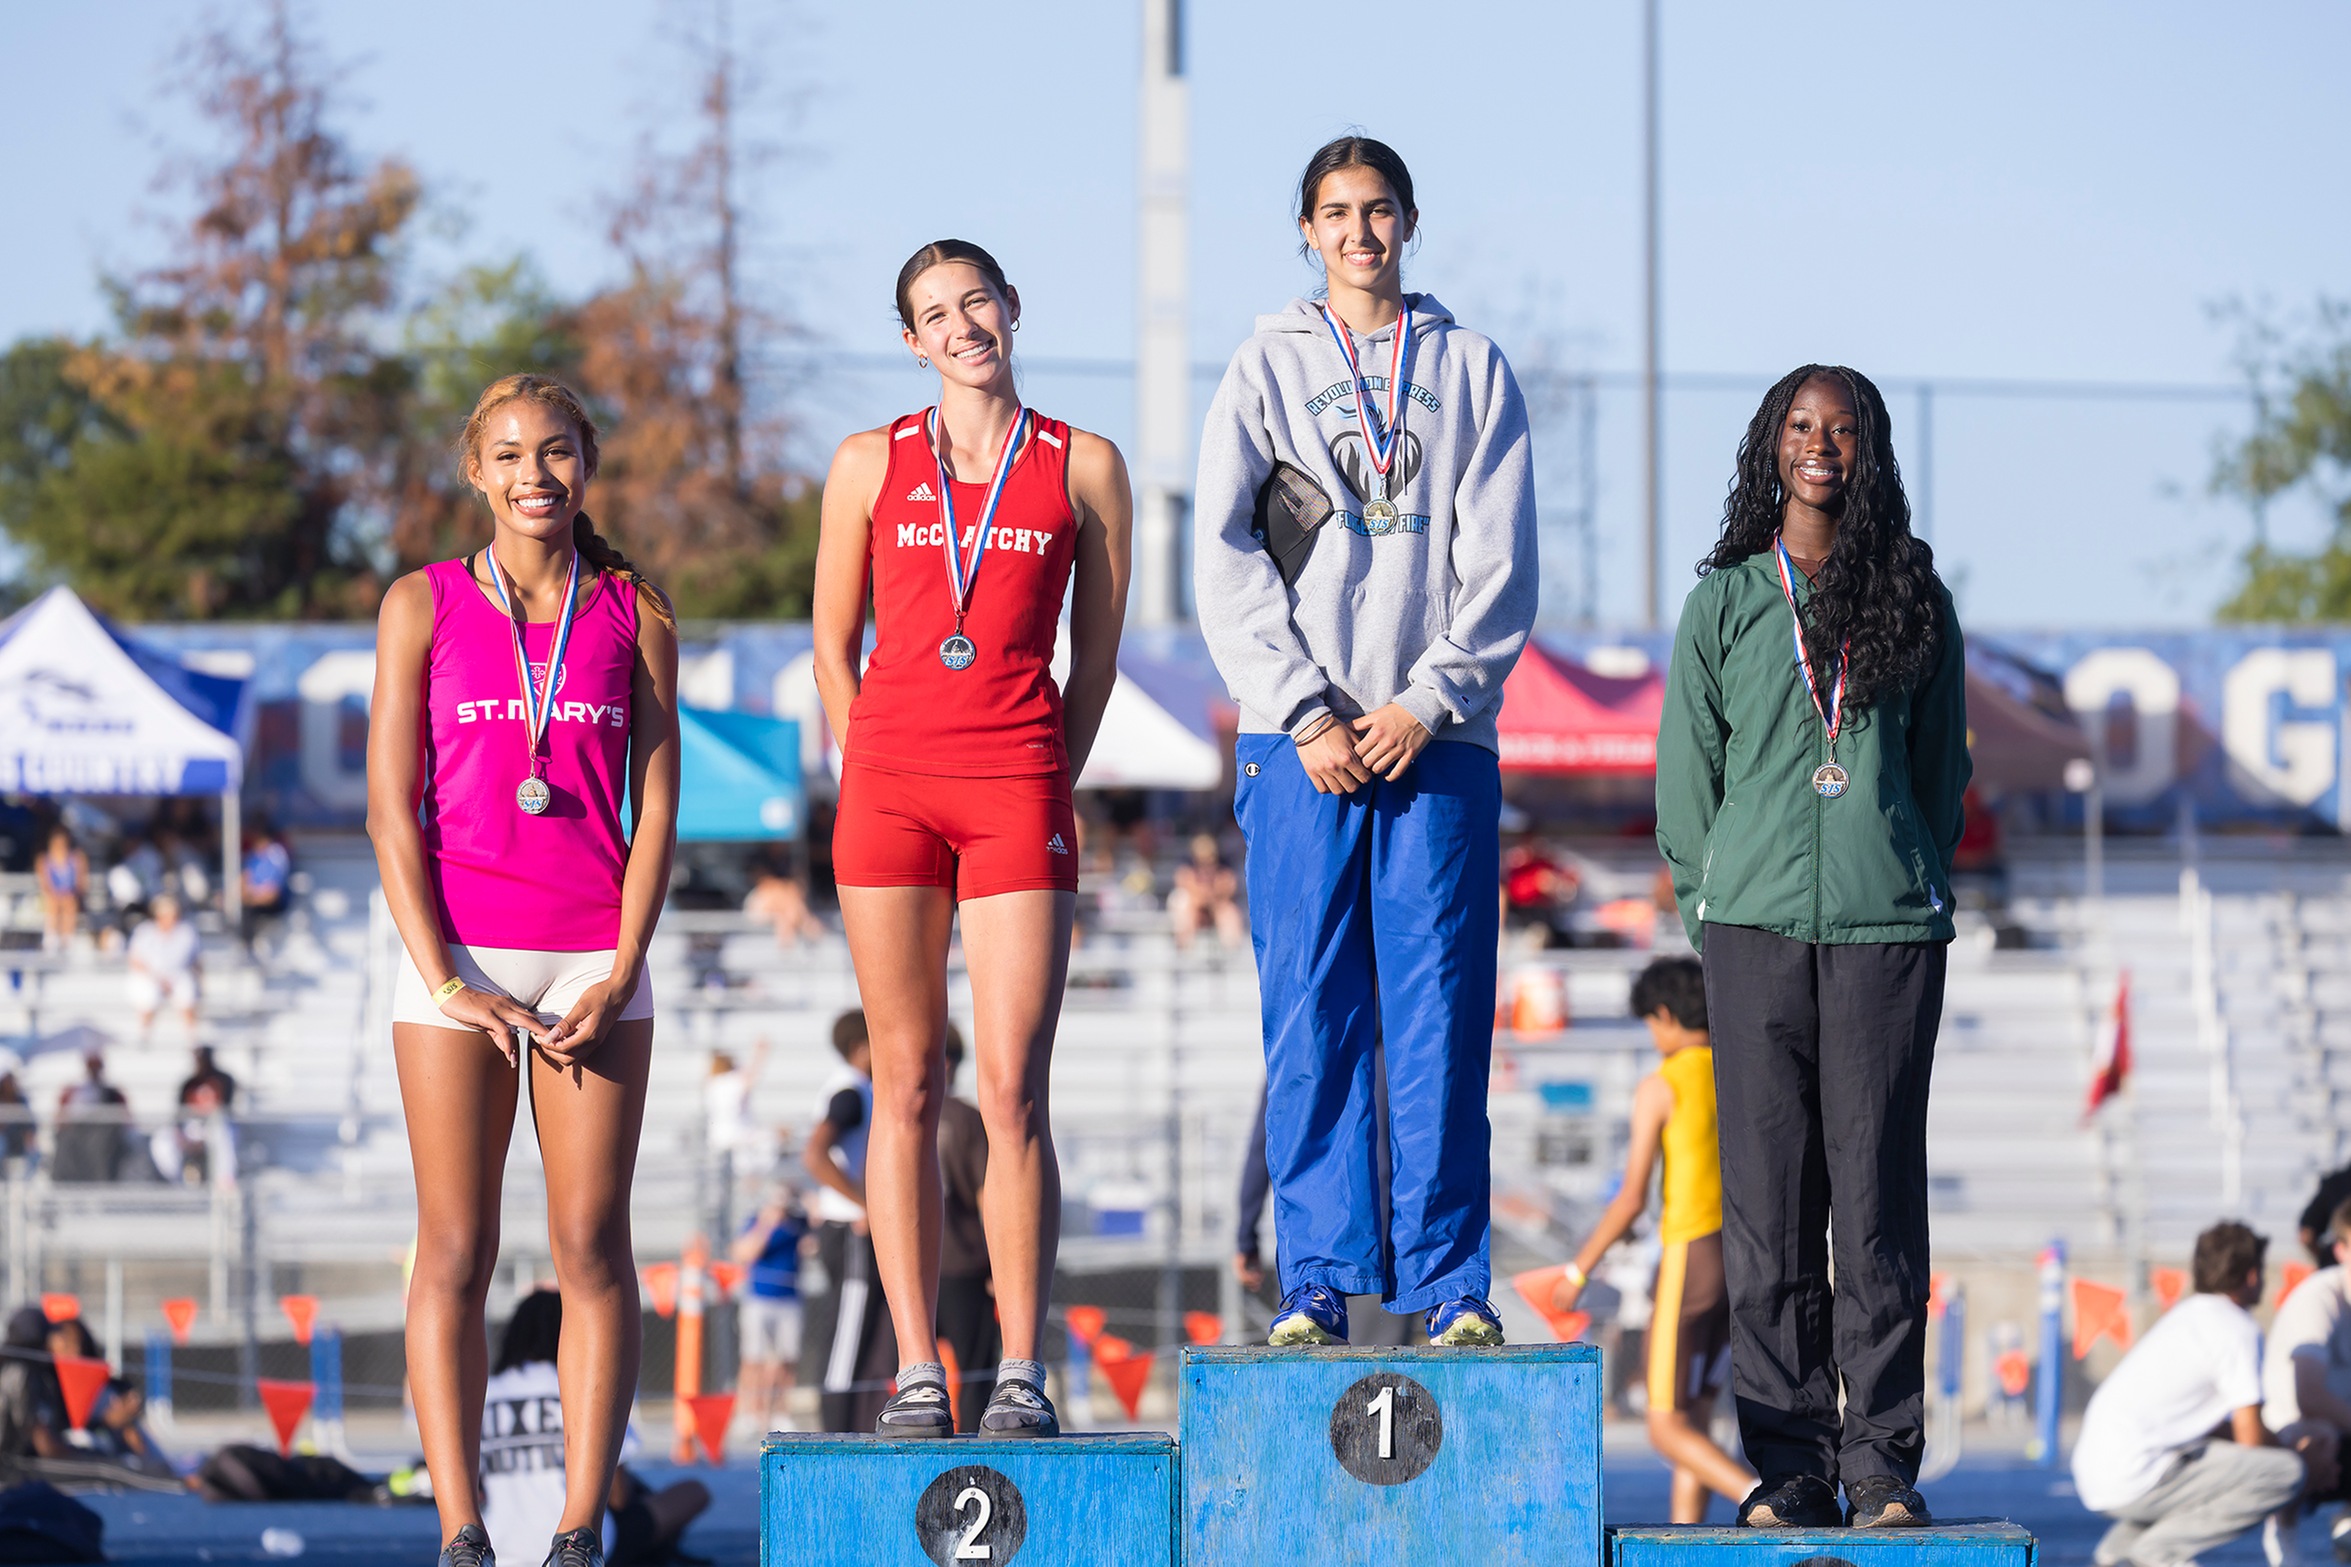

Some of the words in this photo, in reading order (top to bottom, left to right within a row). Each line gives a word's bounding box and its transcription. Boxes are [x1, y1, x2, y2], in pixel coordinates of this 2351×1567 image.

[1305, 375, 1383, 416] REVOLUION
[1383, 377, 1441, 413] EPRESS
[907, 493, 937, 502] adidas
[897, 523, 1053, 556] McCATCHY
[1820, 783, 1842, 793] SJS
[1367, 1387, 1393, 1458] 1
[954, 1487, 991, 1559] 2
